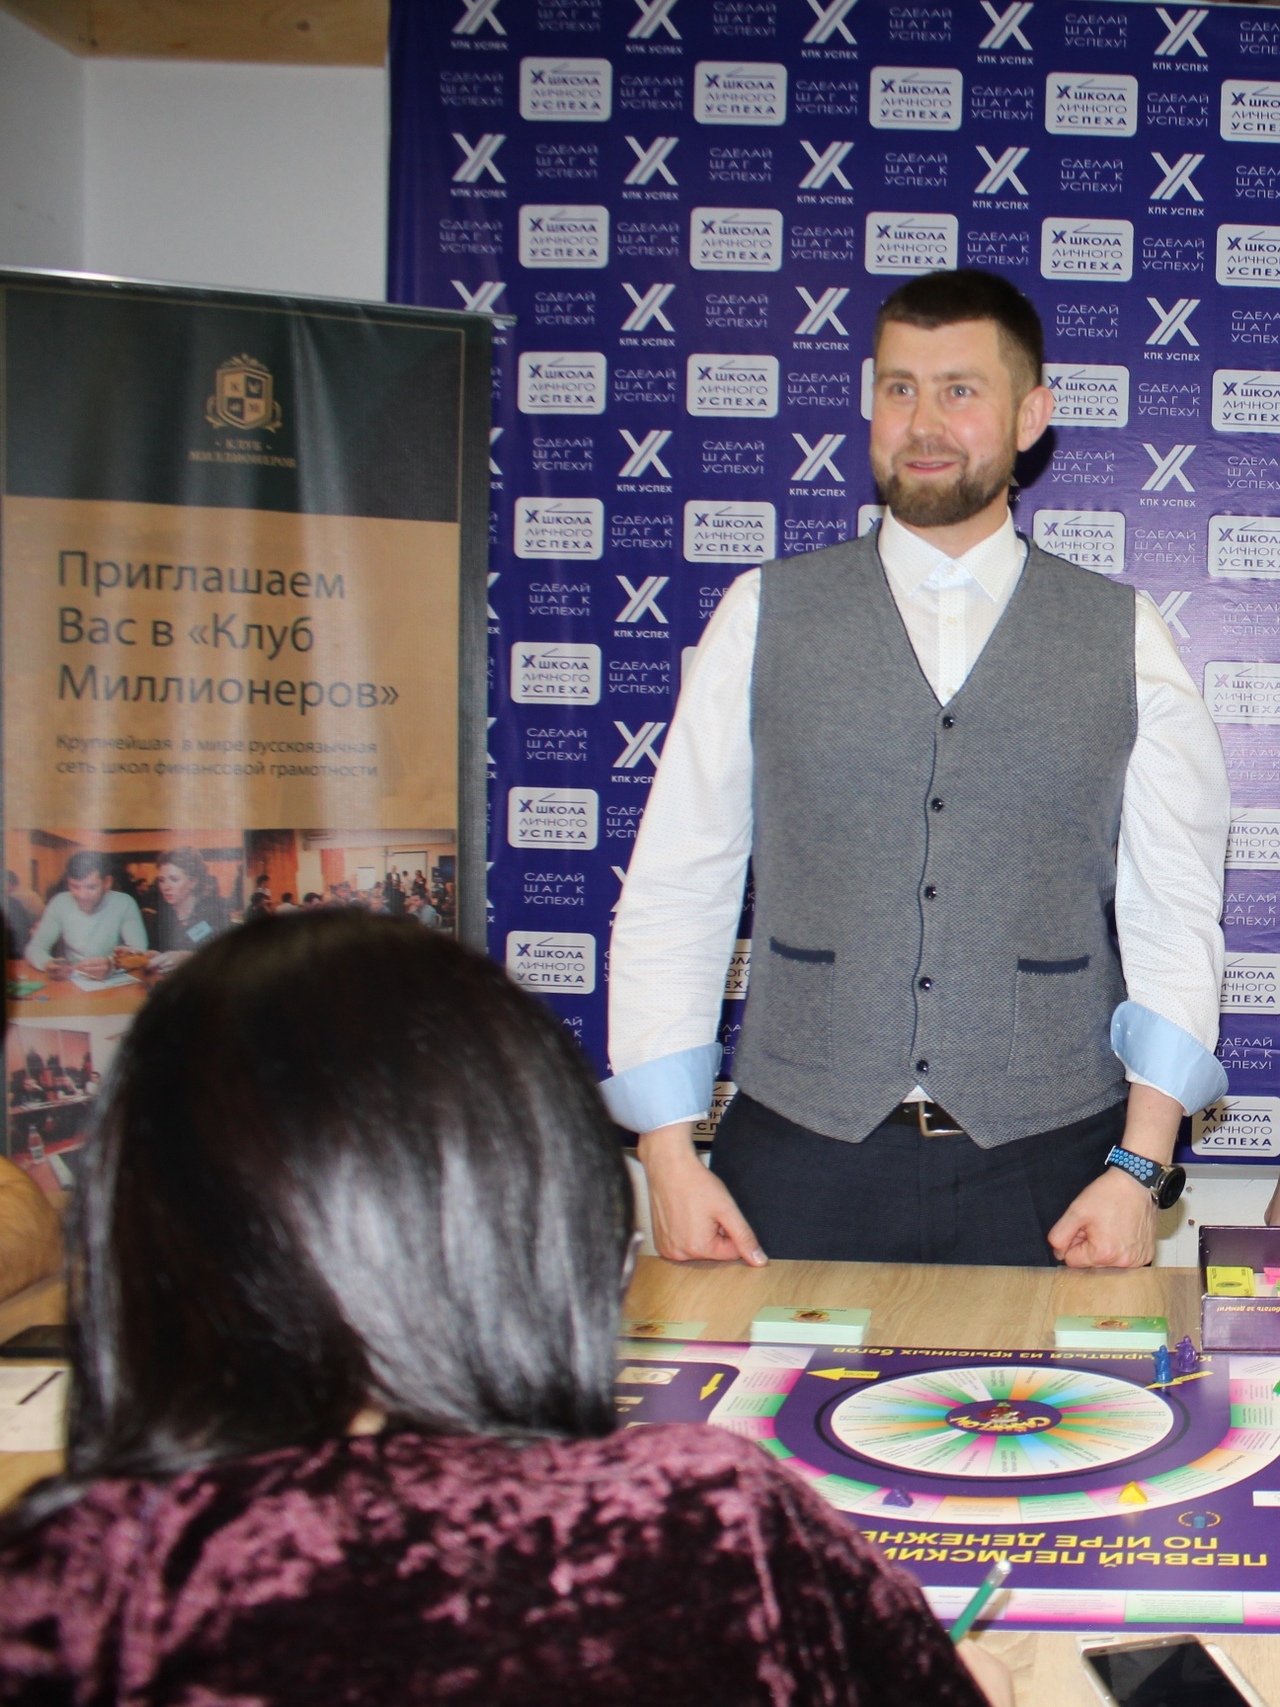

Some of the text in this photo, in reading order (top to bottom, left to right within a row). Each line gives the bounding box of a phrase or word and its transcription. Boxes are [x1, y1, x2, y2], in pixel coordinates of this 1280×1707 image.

[800, 49, 859, 60] КПК УСПЕХ
[898, 85, 951, 96] ШКОЛА
[884, 98, 952, 107] ЛИЧНОГО
[880, 109, 952, 120] УСПЕХА
[1235, 176, 1276, 188] ШАГ
[1147, 205, 1205, 217] КПК УСПЕХ
[1143, 351, 1201, 362] КПК УСПЕХ
[715, 373, 767, 383] ШКОЛА
[701, 385, 768, 395] ЛИЧНОГО
[697, 396, 768, 407] УСПЕХА
[712, 519, 764, 529] ШКОЛА
[698, 532, 765, 541] ЛИЧНОГО
[694, 543, 765, 553] УСПЕХА
[57, 550, 346, 600] Приглашаем
[57, 606, 314, 662] Вас в «Клуб
[613, 629, 671, 640] КПК УСПЕХ
[57, 663, 400, 716] Миллионеров»
[55, 734, 378, 757] Крупнейшая в мире русскоязычная
[55, 759, 379, 780] сеть школ финансовой грамотности
[536, 806, 586, 815] ШКОЛА
[517, 815, 588, 829] ЛИЧНОГО
[519, 829, 587, 839] УСПЕХА
[523, 872, 586, 883] СДЕЛАЙ
[523, 883, 564, 894] ШАГ
[523, 895, 585, 906] УСПЕХУ!
[1220, 1113, 1272, 1122] ШКОЛА
[1203, 1125, 1272, 1135] ЛИЧНОГО
[1203, 1136, 1272, 1146] УСПЕХА
[832, 1345, 1158, 1362] ырваться из крысиных бегов
[1054, 1534, 1152, 1549] ИГРЕ
[1163, 1534, 1219, 1550] ПО
[1098, 1551, 1268, 1568] ПЕРВЫЙ
